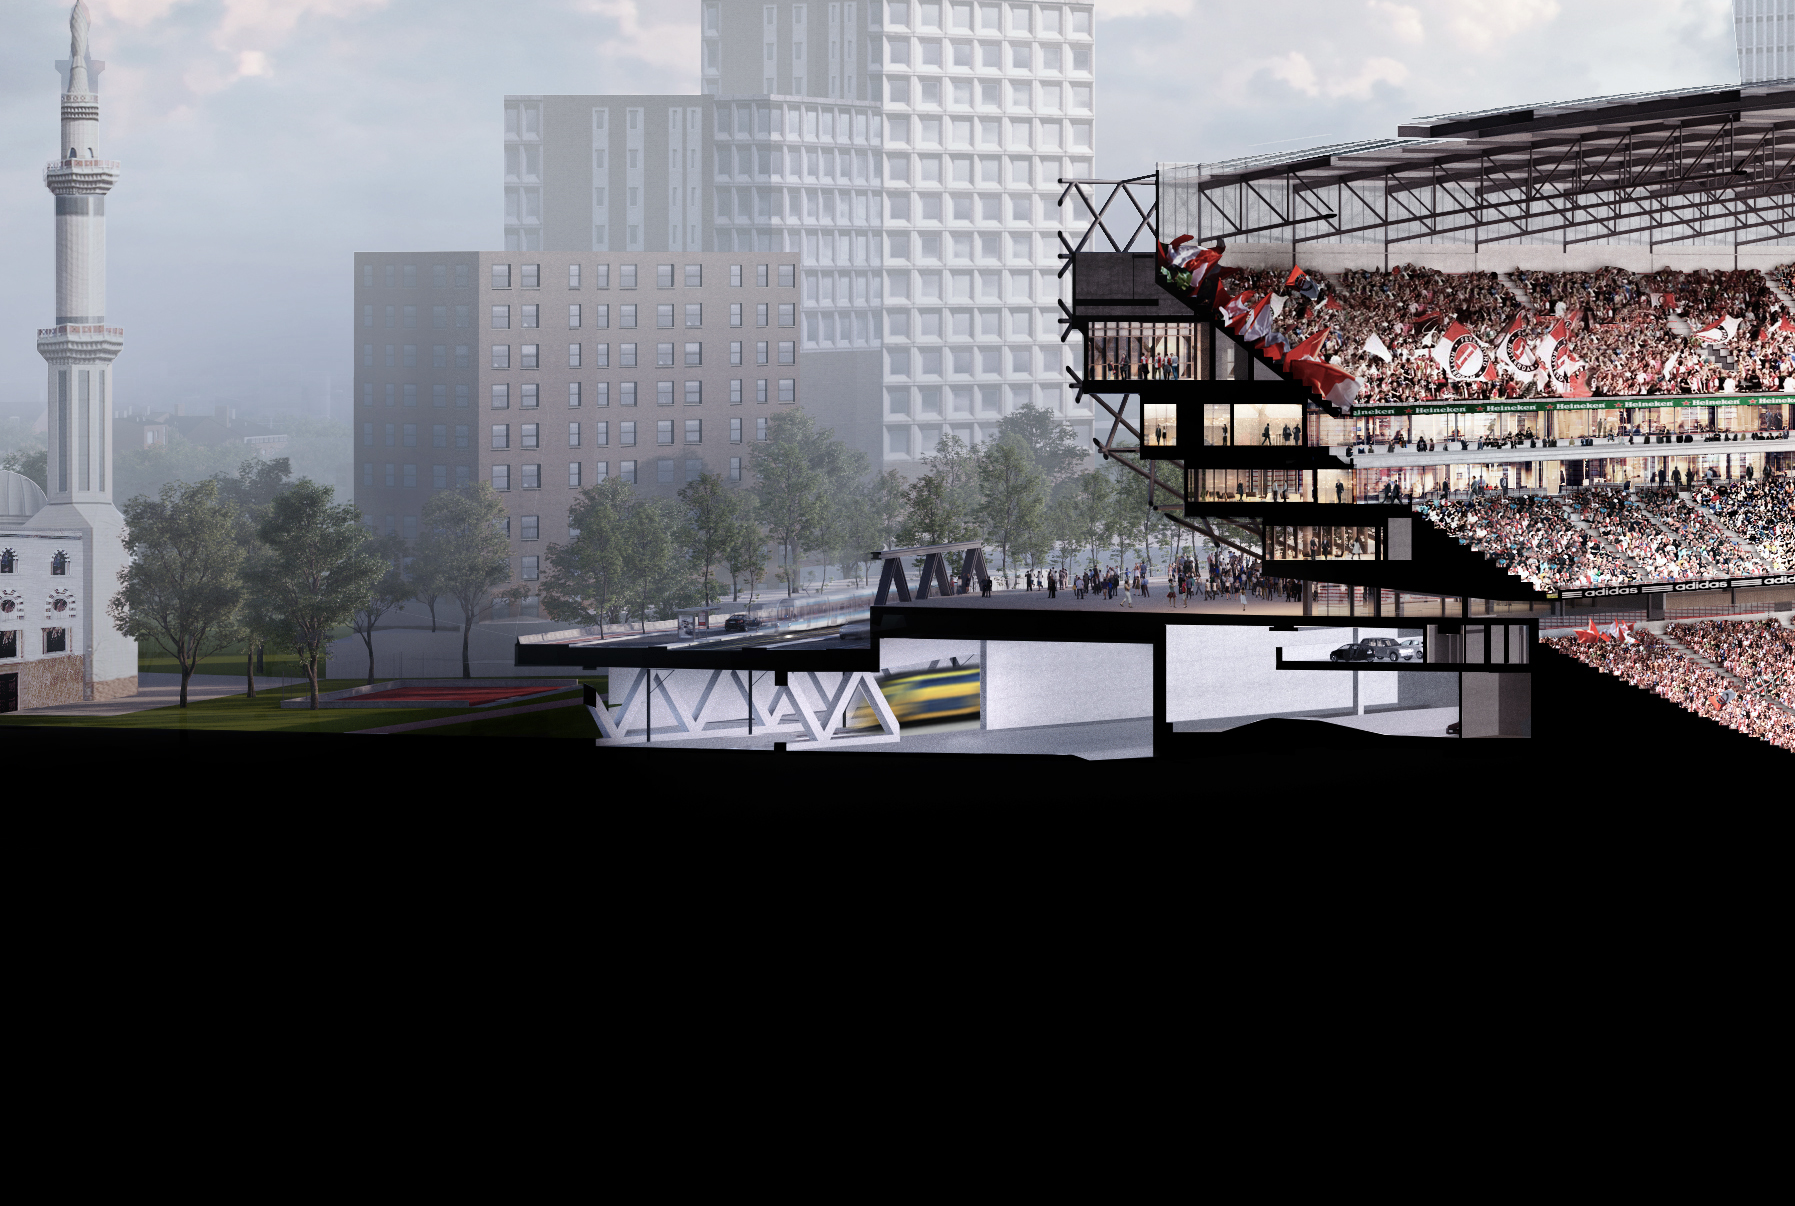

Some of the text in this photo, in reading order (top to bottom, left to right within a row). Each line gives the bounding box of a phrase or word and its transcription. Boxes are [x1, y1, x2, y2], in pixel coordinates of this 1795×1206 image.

[1556, 402, 1606, 410] Heineken
[1624, 400, 1672, 408] Heineken
[1692, 398, 1740, 406] Heineken
[1585, 586, 1638, 596] adidas
[1675, 580, 1727, 591] adidas
